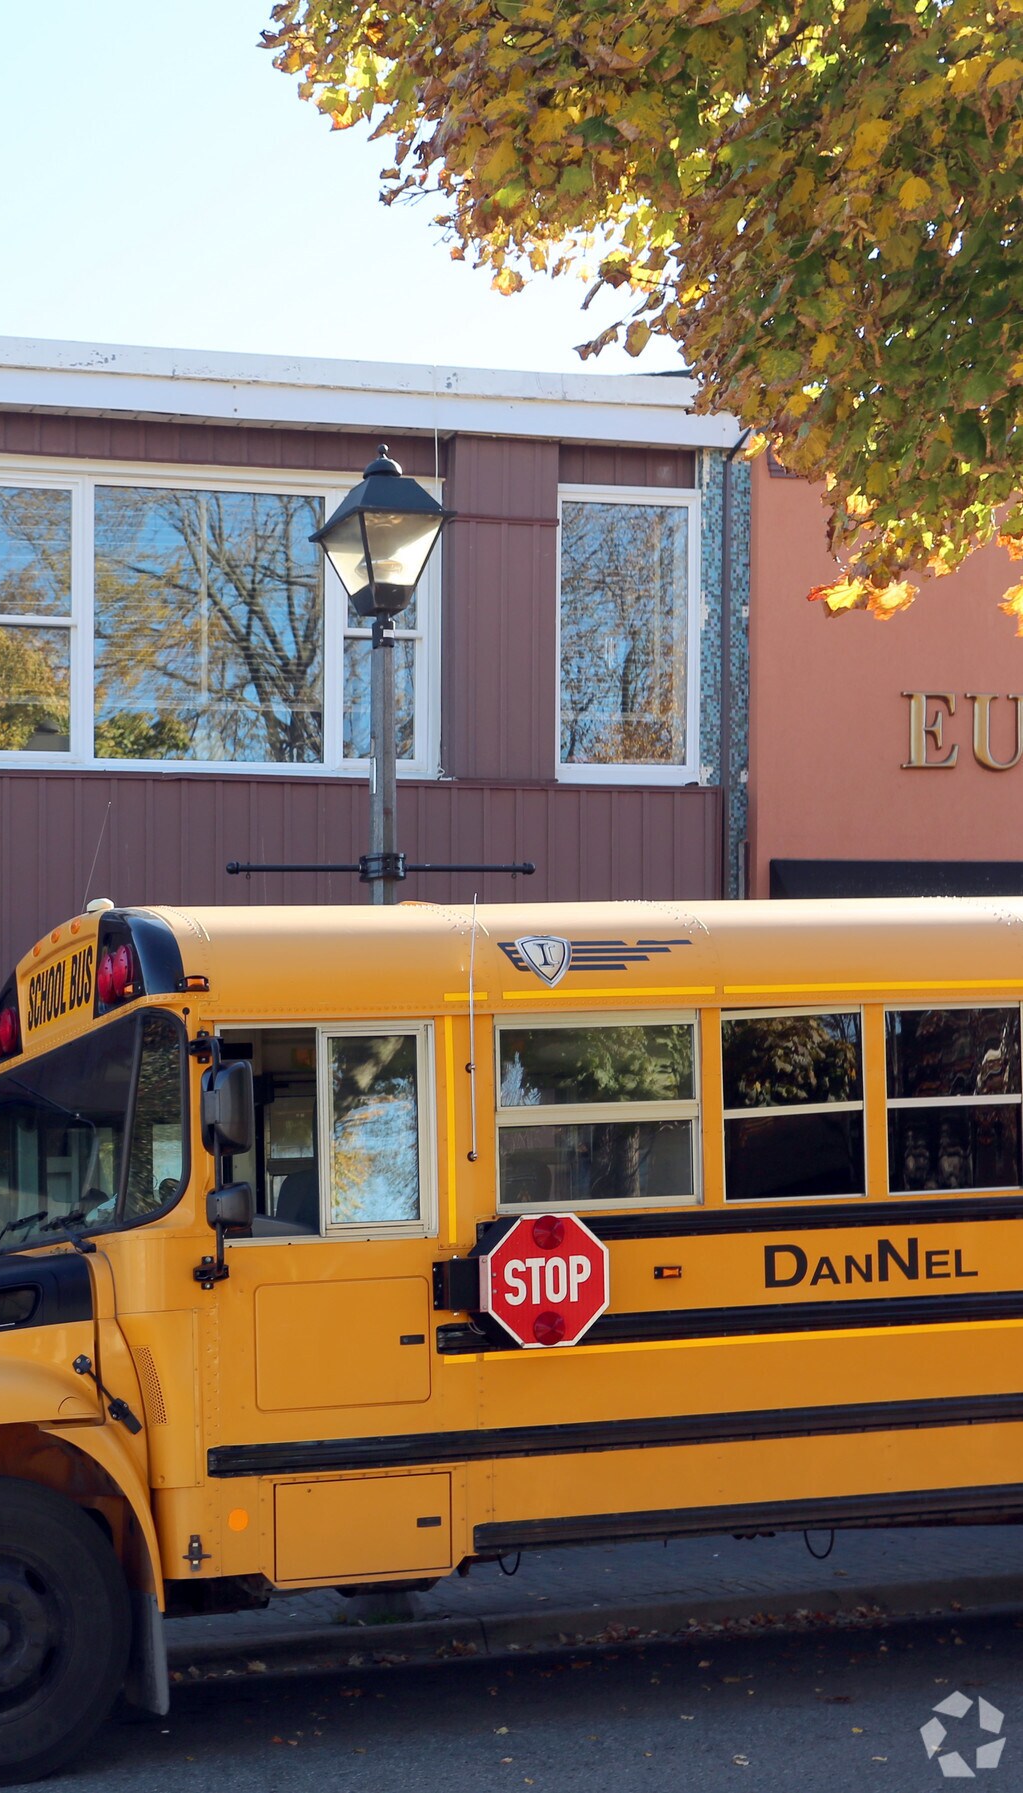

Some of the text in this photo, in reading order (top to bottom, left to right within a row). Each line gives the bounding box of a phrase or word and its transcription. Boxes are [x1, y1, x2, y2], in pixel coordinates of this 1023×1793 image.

[28, 945, 93, 1032] SCHOOL BUS
[504, 1254, 592, 1306] STOP
